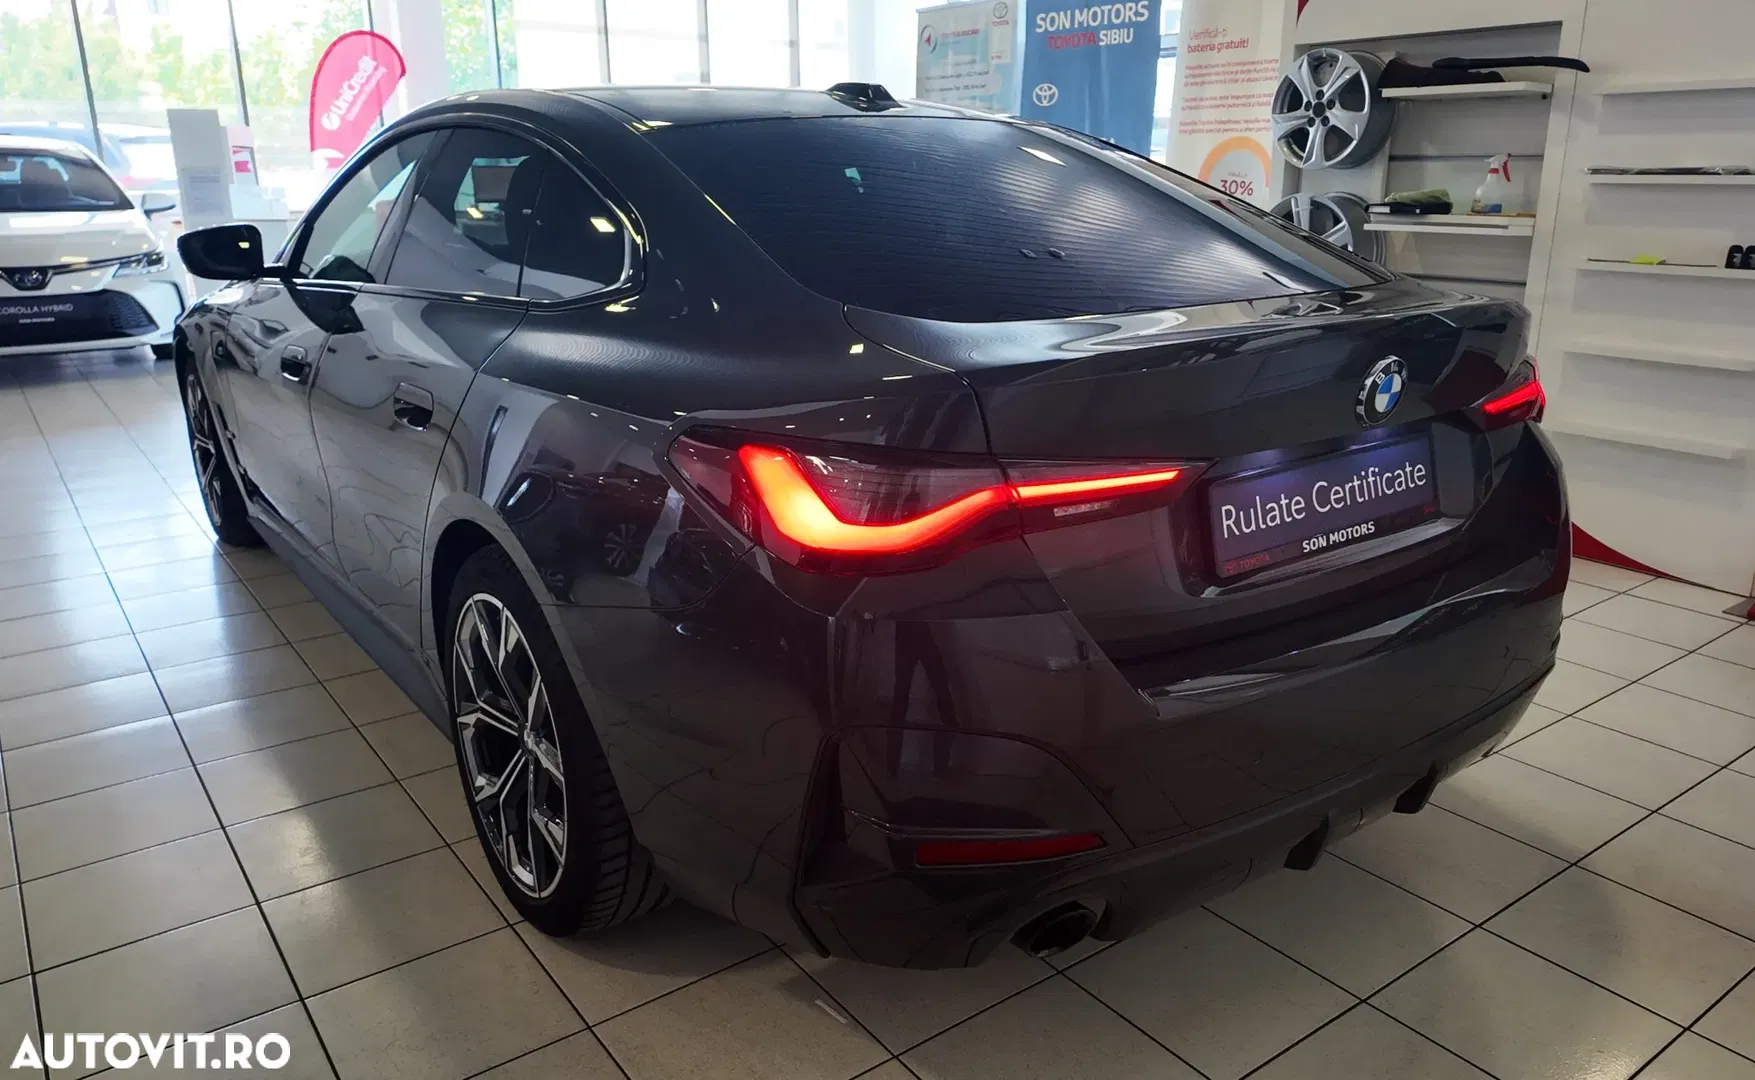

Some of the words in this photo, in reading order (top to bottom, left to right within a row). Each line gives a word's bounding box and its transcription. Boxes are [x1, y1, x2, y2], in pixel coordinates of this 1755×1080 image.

[1035, 10, 1071, 33] SON
[1074, 1, 1149, 28] MOTORS
[1047, 32, 1096, 50] TOYOTA
[1099, 28, 1134, 46] SIBIU
[1187, 42, 1216, 53] bateria
[1217, 38, 1249, 53] gratuit!
[329, 55, 377, 118] UniCredit
[1220, 179, 1254, 196] 30%
[41, 303, 73, 312] HYBRID
[1221, 493, 1305, 539] Rulate
[1312, 461, 1426, 513] Certificate
[1302, 535, 1327, 553] SON
[1329, 521, 1376, 545] MOTORS
[1239, 553, 1270, 569] TOYOTA
